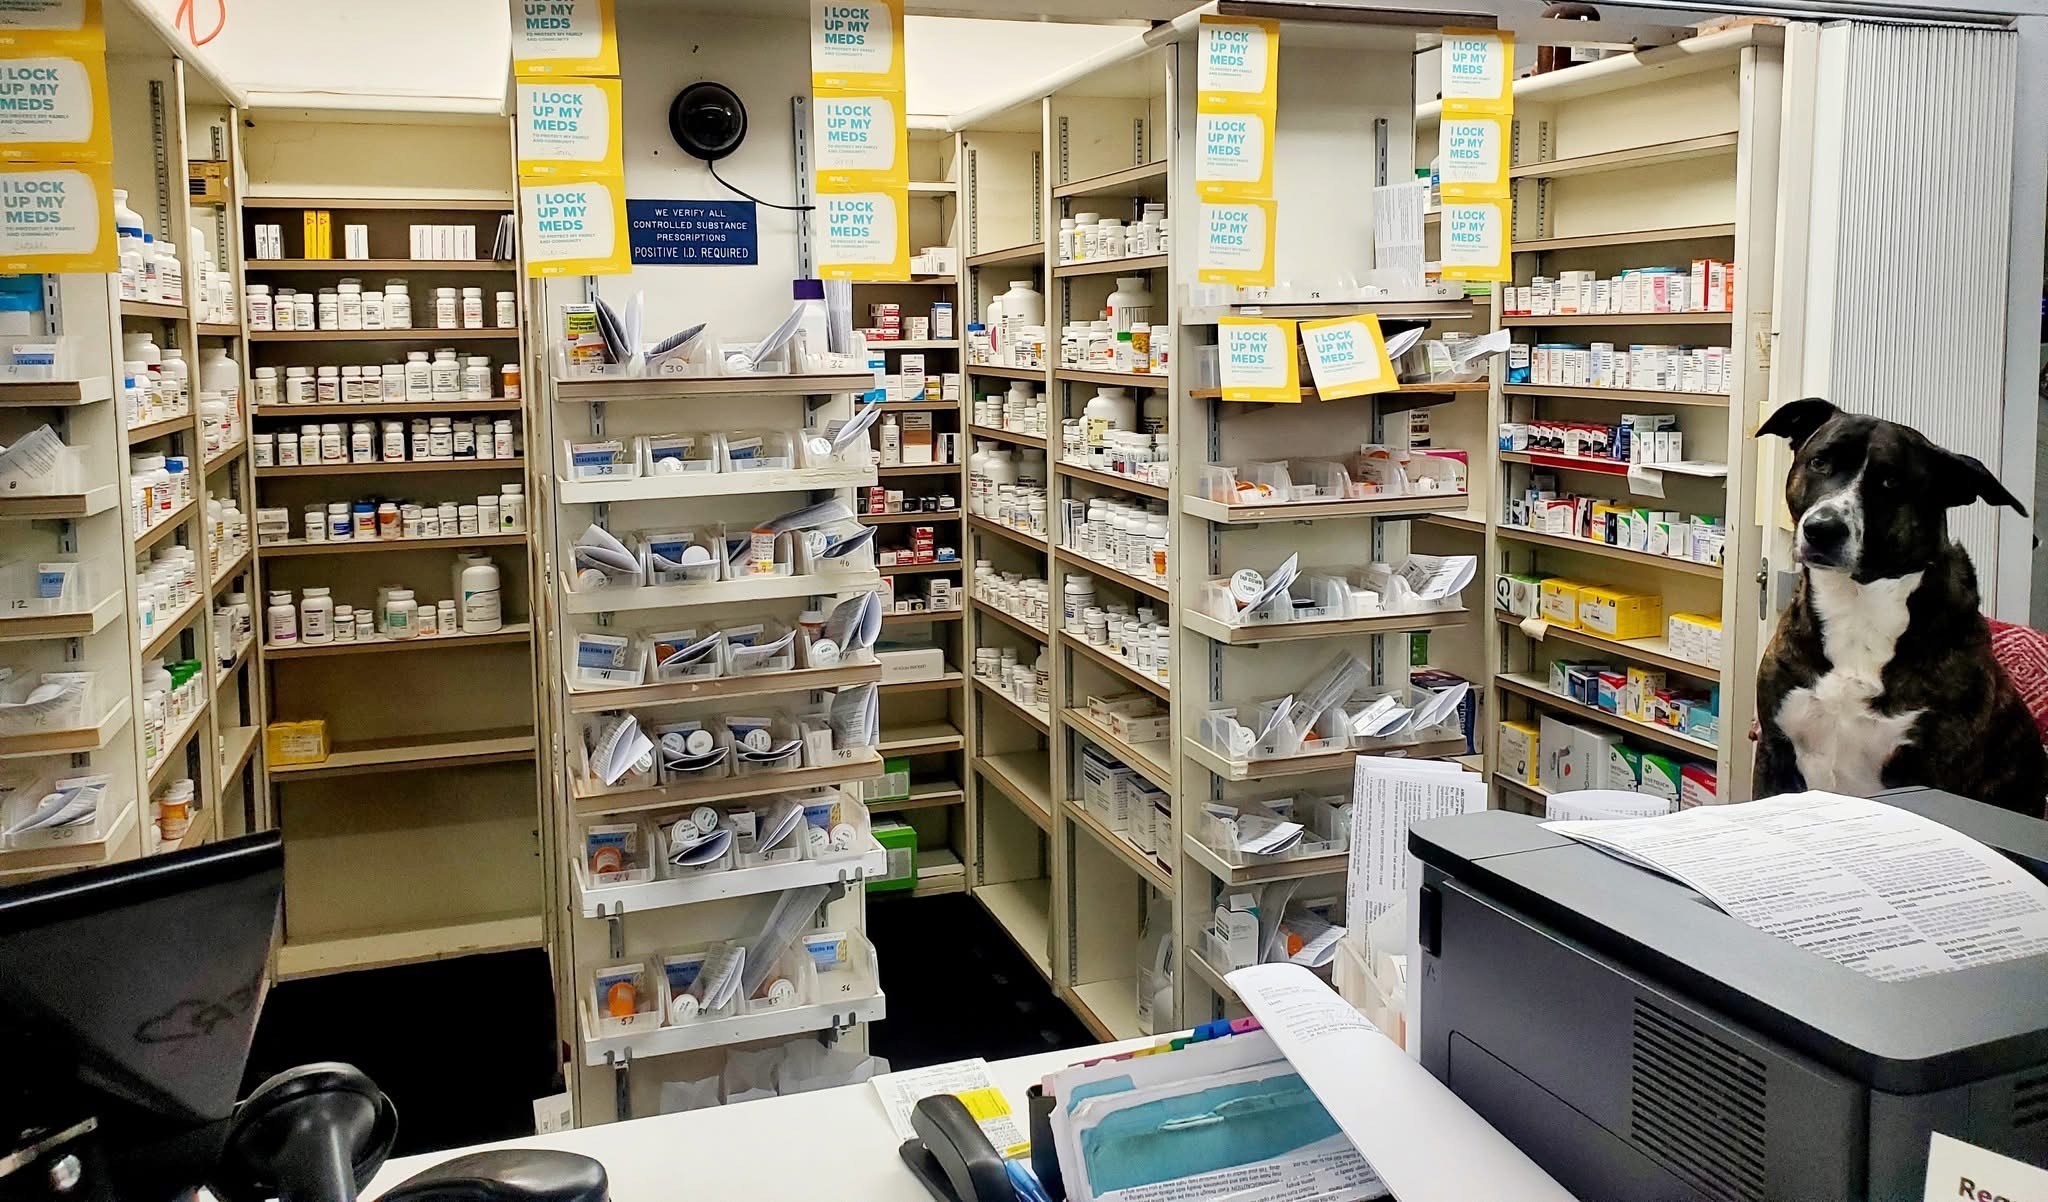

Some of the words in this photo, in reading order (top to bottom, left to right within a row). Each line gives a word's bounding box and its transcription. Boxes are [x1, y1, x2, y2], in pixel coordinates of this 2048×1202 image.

[525, 4, 547, 15] UP
[551, 4, 574, 15] MY
[832, 7, 869, 20] LOCK
[526, 18, 570, 29] MEDS
[825, 20, 843, 31] UP
[848, 21, 869, 32] MY
[825, 33, 864, 45] MEDS
[1218, 31, 1249, 42] LOCK
[1210, 42, 1226, 53] UP
[1230, 44, 1248, 54] MY
[1460, 41, 1487, 52] LOCK
[1210, 55, 1244, 66] MEDS
[1453, 53, 1467, 62] UP
[1471, 54, 1487, 63] MY
[8, 68, 59, 80] LOCK
[1453, 64, 1483, 74] MEDS
[0, 84, 24, 95] UP
[30, 84, 59, 96] MY
[542, 92, 583, 105] LOCK
[1, 99, 54, 110] MEDS
[533, 106, 554, 117] UP
[559, 107, 583, 118] MY
[836, 105, 871, 116] LOCK
[533, 119, 577, 132] MEDS
[827, 119, 846, 128] UP
[851, 119, 871, 129] MY
[1216, 121, 1246, 132] LOCK
[828, 131, 867, 142] MEDS
[1457, 127, 1484, 136] LOCK
[1208, 133, 1224, 142] UP
[1227, 134, 1246, 144] MY
[1450, 138, 1464, 147] UP
[1468, 139, 1484, 147] MY
[1208, 145, 1240, 156] MEDS
[1450, 150, 1479, 159] MEDS
[14, 182, 65, 193] LOCK
[4, 197, 30, 208] UP
[37, 197, 65, 208] MY
[546, 193, 587, 204] LOCK
[838, 201, 874, 211] LOCK
[6, 211, 61, 223] MEDS
[538, 207, 559, 218] UP
[564, 206, 587, 217] MY
[655, 209, 668, 217] WE
[673, 209, 704, 217] VERIFY
[709, 209, 726, 217] ALL
[1218, 211, 1248, 222] LOCK
[1458, 211, 1485, 220] LOCK
[830, 214, 848, 224] UP
[853, 214, 874, 224] MY
[539, 220, 583, 231] MEDS
[633, 221, 692, 229] CONTROLLED
[696, 222, 747, 230] SUBSTANCE
[1211, 222, 1226, 232] UP
[1230, 224, 1248, 234] MY
[1452, 222, 1465, 230] UP
[1469, 223, 1485, 231] MY
[831, 227, 869, 237] MEDS
[1452, 233, 1481, 242] MEDS
[1211, 234, 1243, 245] MEDS
[635, 247, 679, 258] POSITIVE
[684, 248, 697, 258] I.D.
[701, 248, 749, 258] REQUIRED
[1237, 332, 1267, 341] LOCK
[1321, 330, 1352, 343] LOCK
[1230, 343, 1247, 352] UP
[1250, 344, 1267, 353] MY
[1317, 344, 1334, 354] UP
[1337, 341, 1354, 350] MY
[1231, 354, 1264, 364] MEDS
[1320, 352, 1354, 364] MEDS
[590, 365, 604, 374] 29
[665, 365, 683, 373] 30
[597, 466, 613, 474] 33
[10, 481, 16, 489] 8
[1496, 577, 1510, 612] G7
[11, 600, 28, 608] 12
[600, 671, 611, 679] 41
